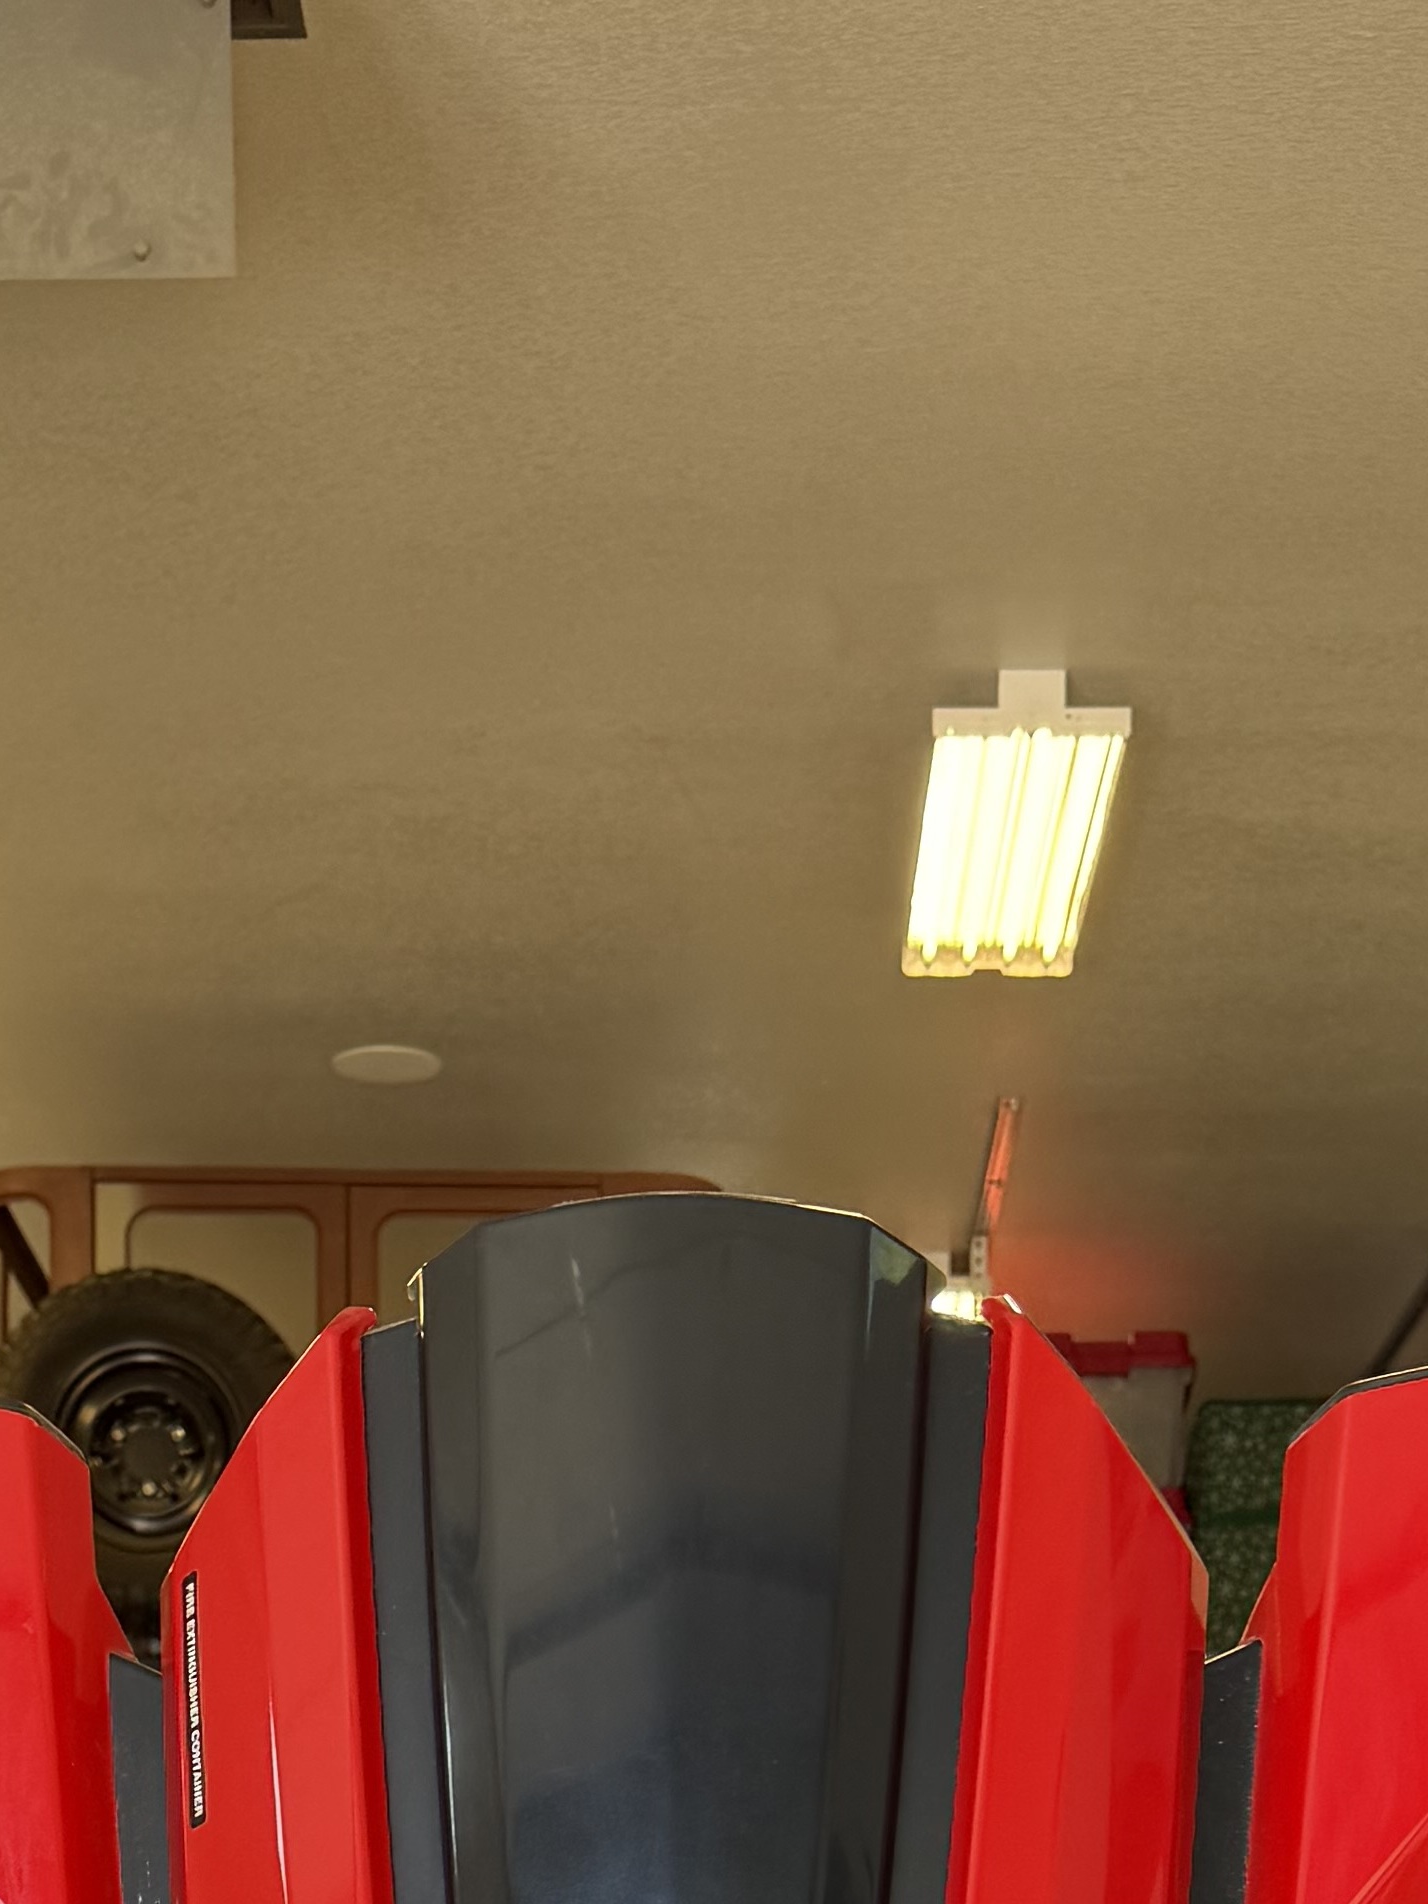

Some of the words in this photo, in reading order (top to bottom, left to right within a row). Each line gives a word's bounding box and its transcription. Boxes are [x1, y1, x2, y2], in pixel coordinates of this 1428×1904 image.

[184, 1582, 195, 1618] FIRE
[186, 1619, 199, 1728] EXTINGUISHER
[191, 1730, 204, 1818] CONTAINER
